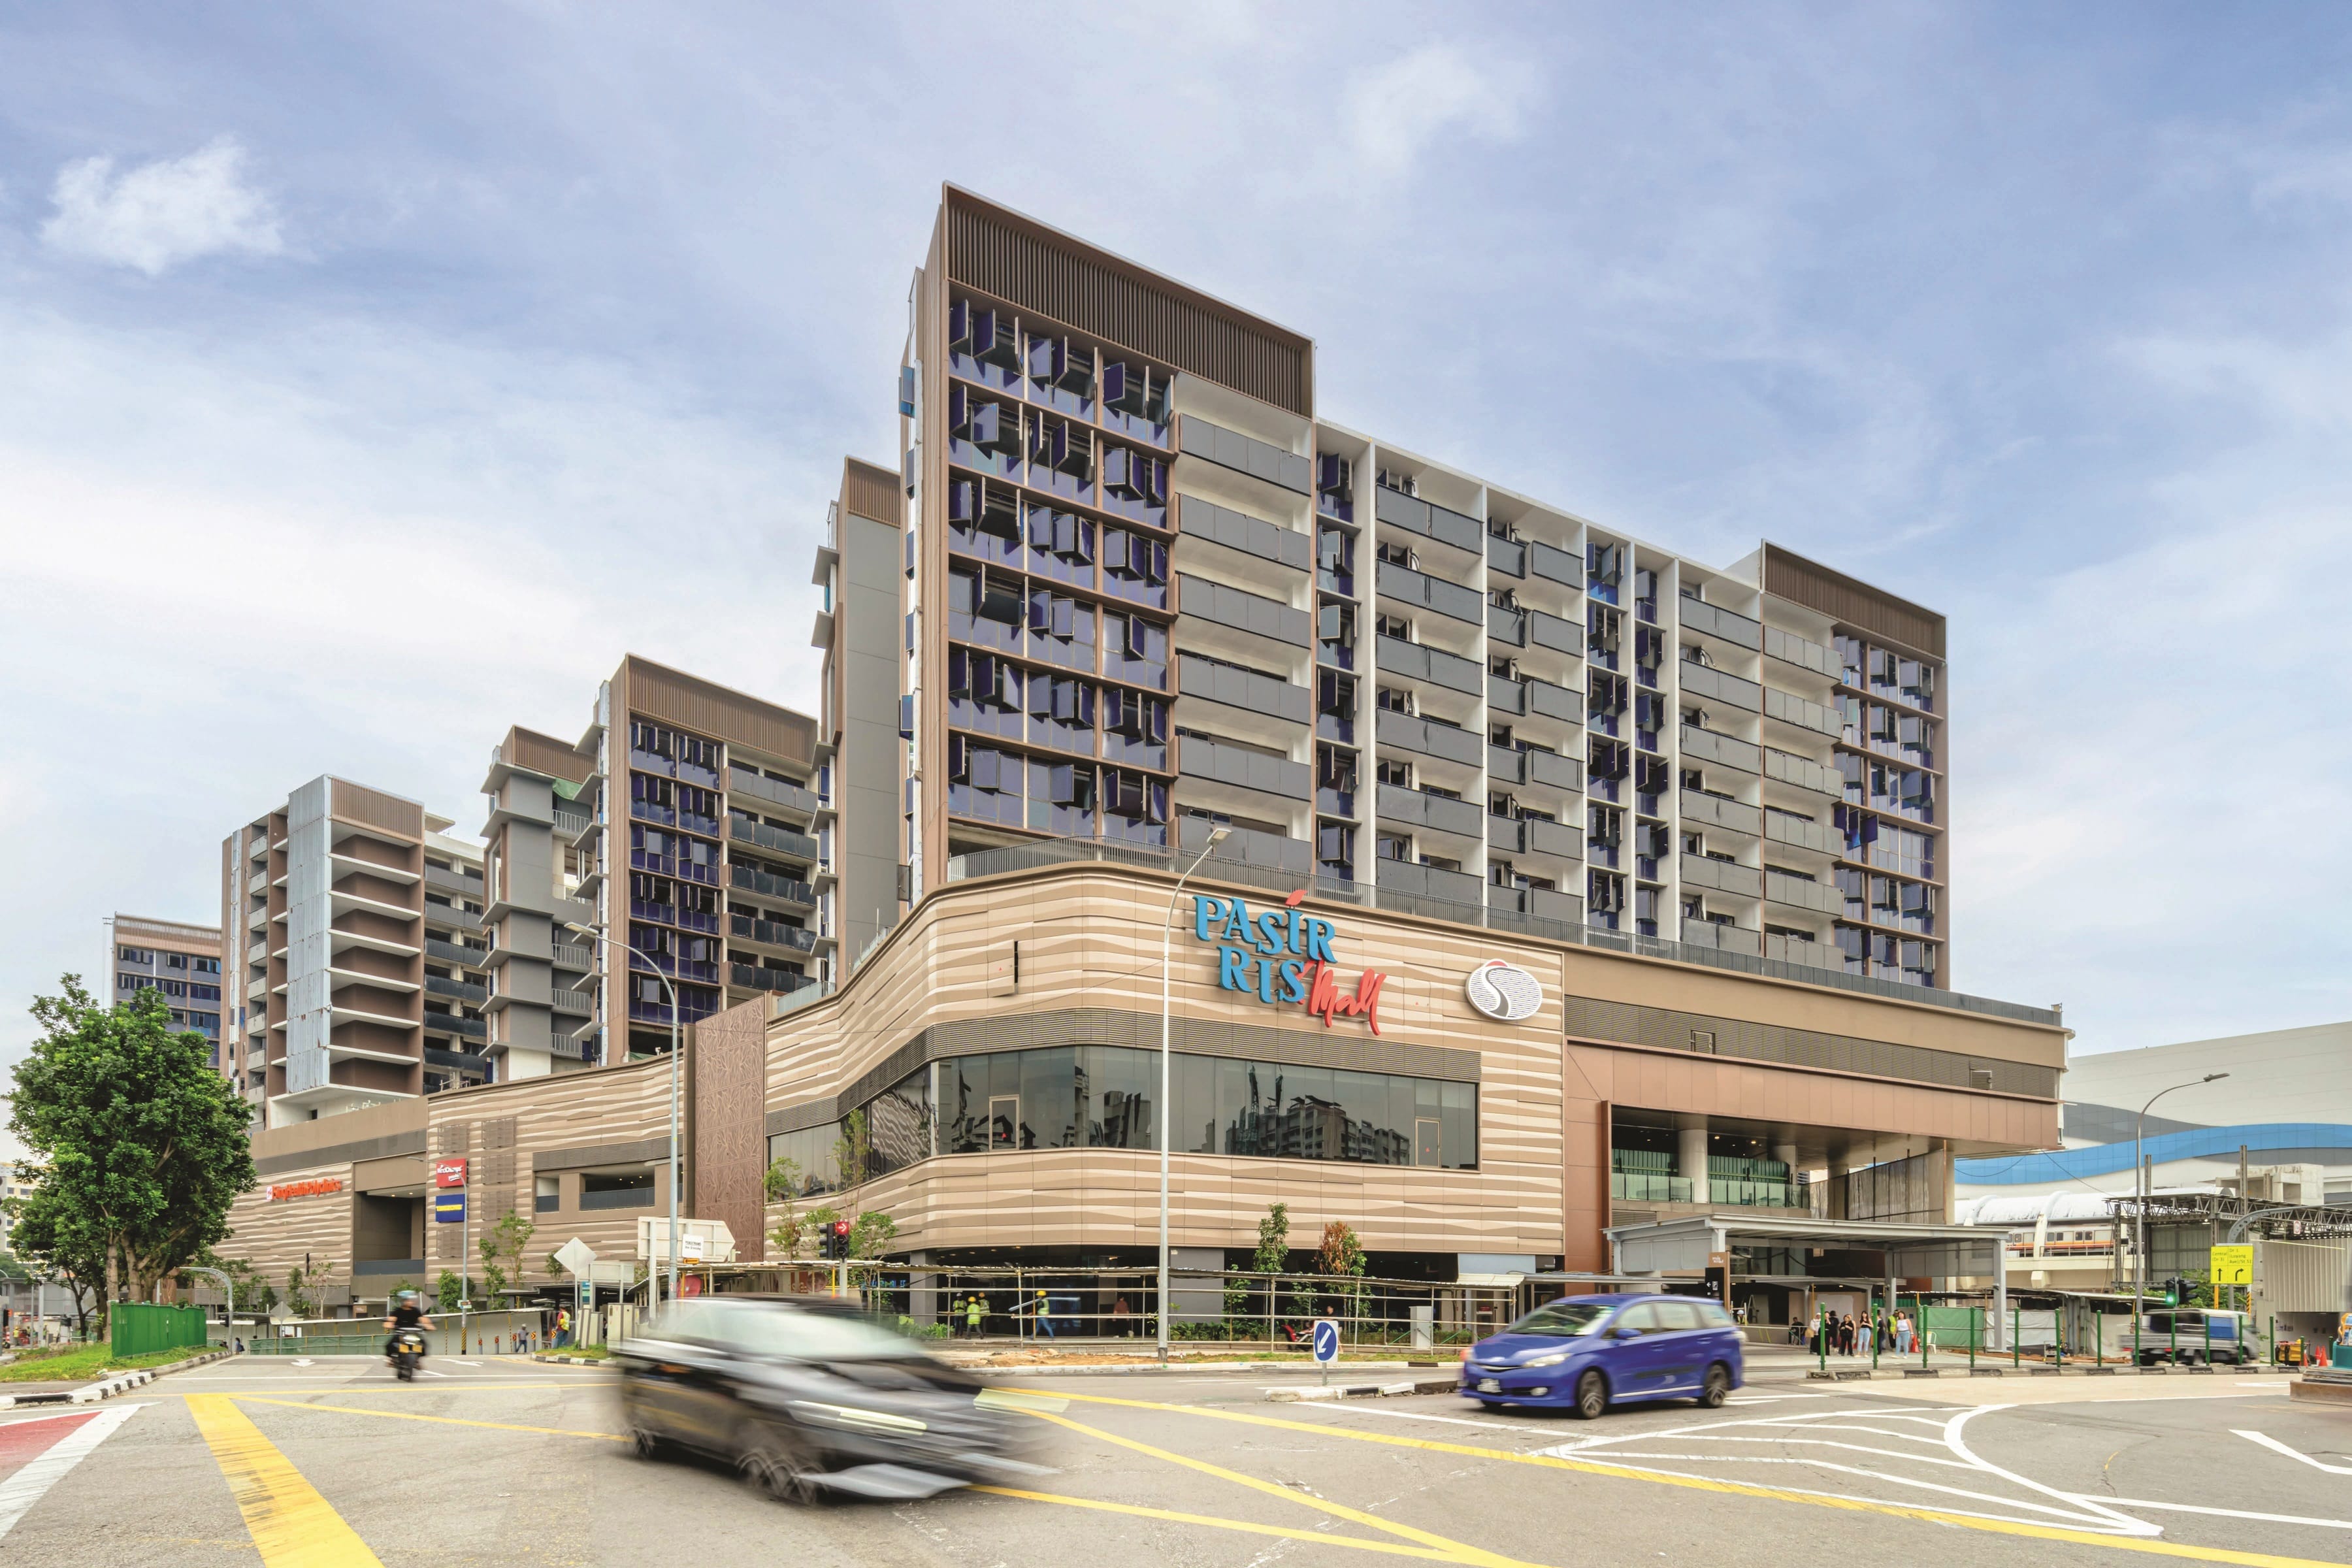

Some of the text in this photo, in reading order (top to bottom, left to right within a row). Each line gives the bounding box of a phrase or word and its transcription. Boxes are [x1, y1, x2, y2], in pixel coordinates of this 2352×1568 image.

[1192, 890, 1337, 964] PASIR
[1217, 945, 1387, 1036] RIS Mall
